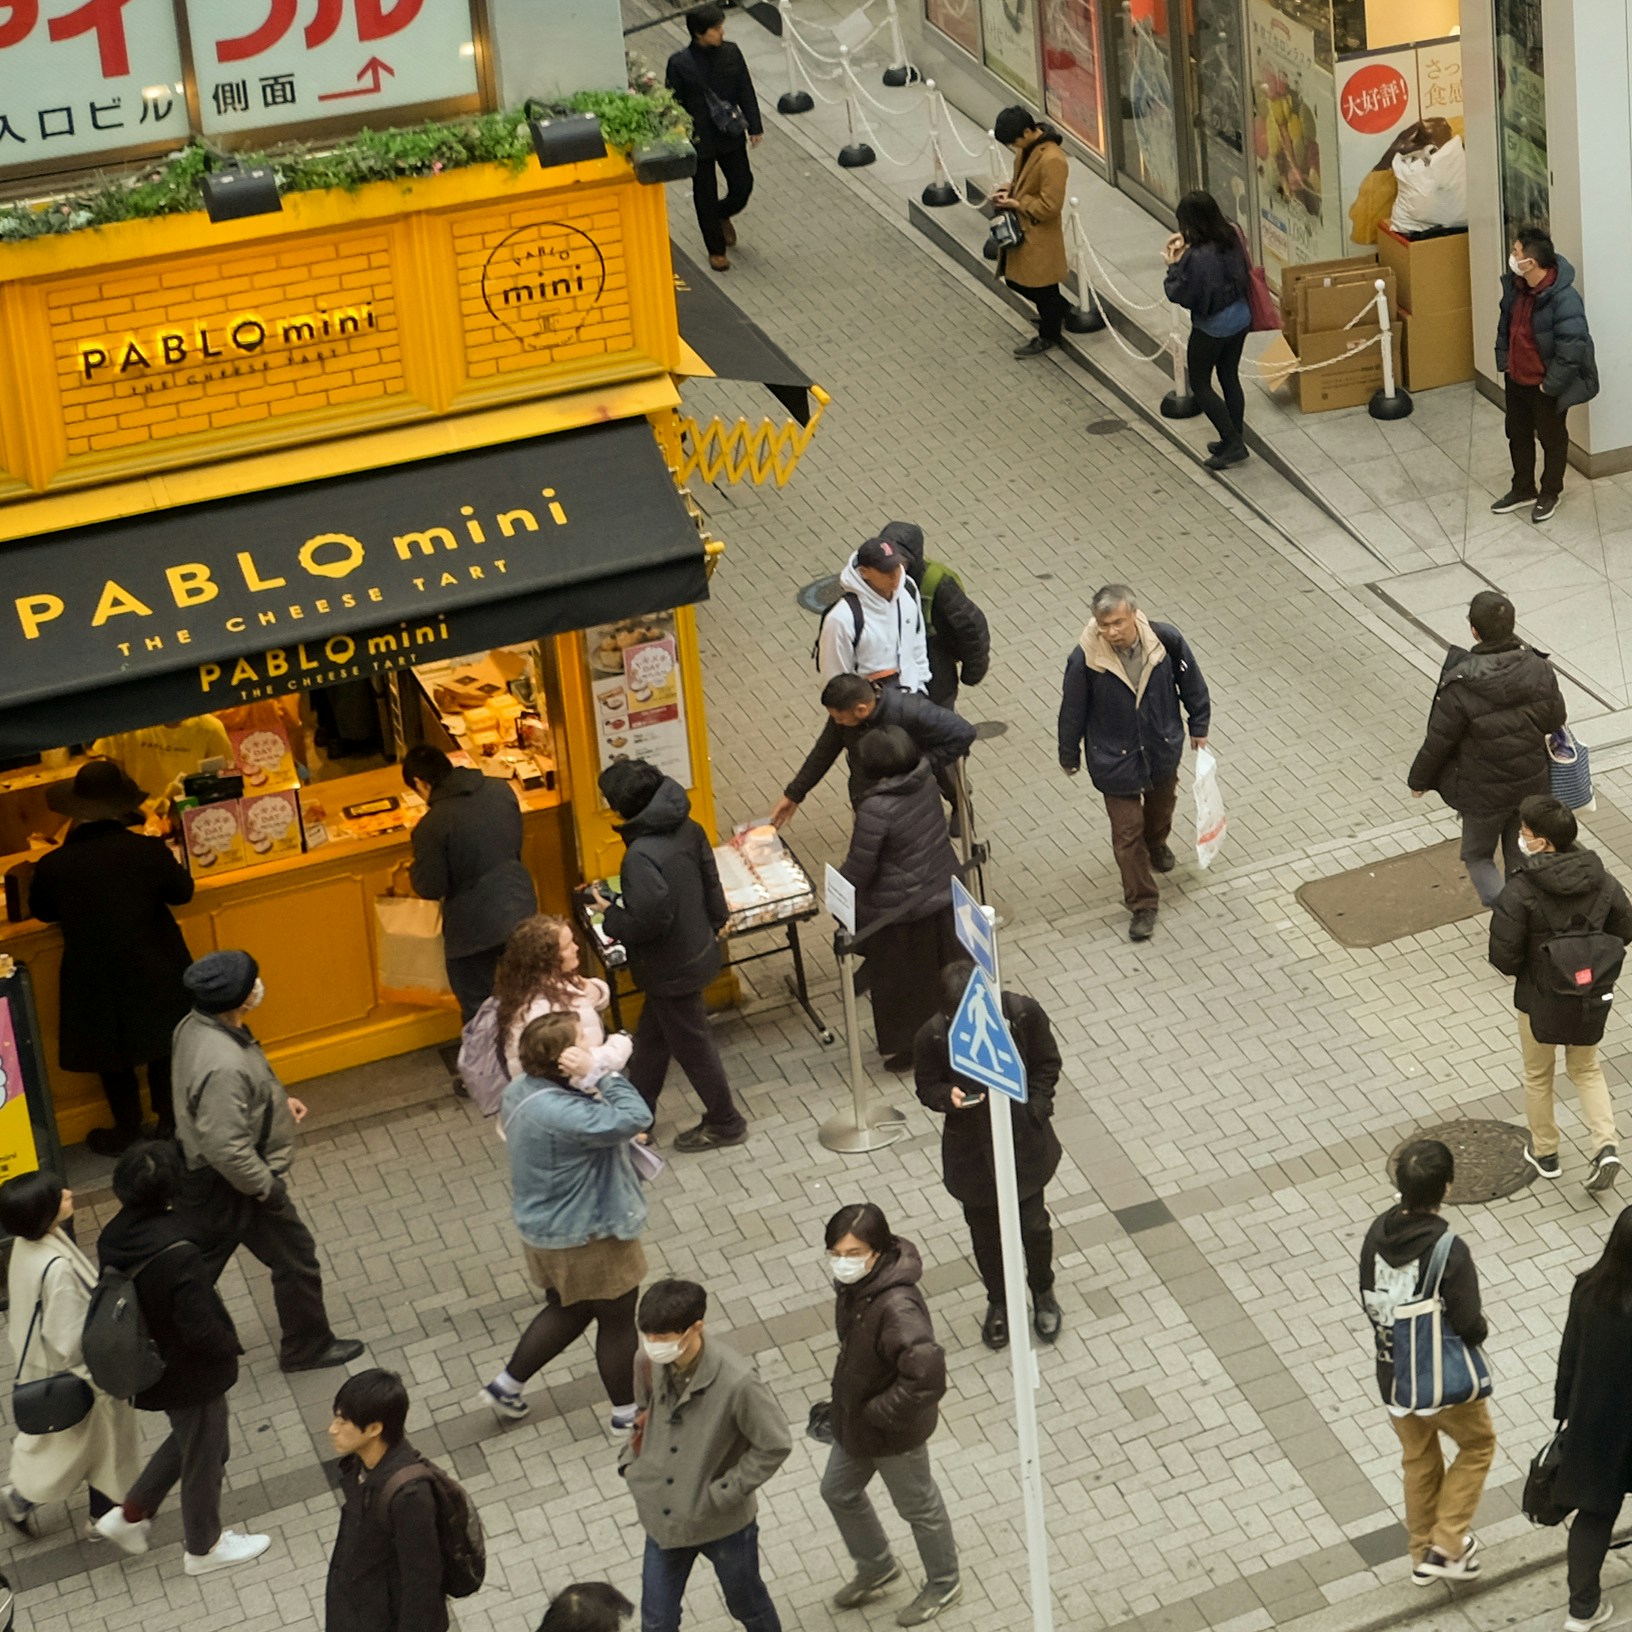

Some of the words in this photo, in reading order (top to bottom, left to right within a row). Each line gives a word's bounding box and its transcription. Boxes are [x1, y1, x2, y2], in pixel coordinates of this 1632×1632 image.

[1343, 77, 1409, 122] 大好評!
[502, 264, 584, 305] mini
[81, 318, 267, 381] PABLO
[282, 301, 376, 344] mini
[15, 533, 366, 640] PABLO
[392, 487, 570, 563] mini
[117, 627, 192, 658] THE
[226, 587, 384, 634] CHEESE
[413, 558, 509, 592] TART
[200, 634, 356, 693] PABLO
[367, 614, 451, 656] mini
[240, 679, 274, 702] THE
[287, 665, 360, 691] CHEESE
[371, 652, 417, 671] TART
